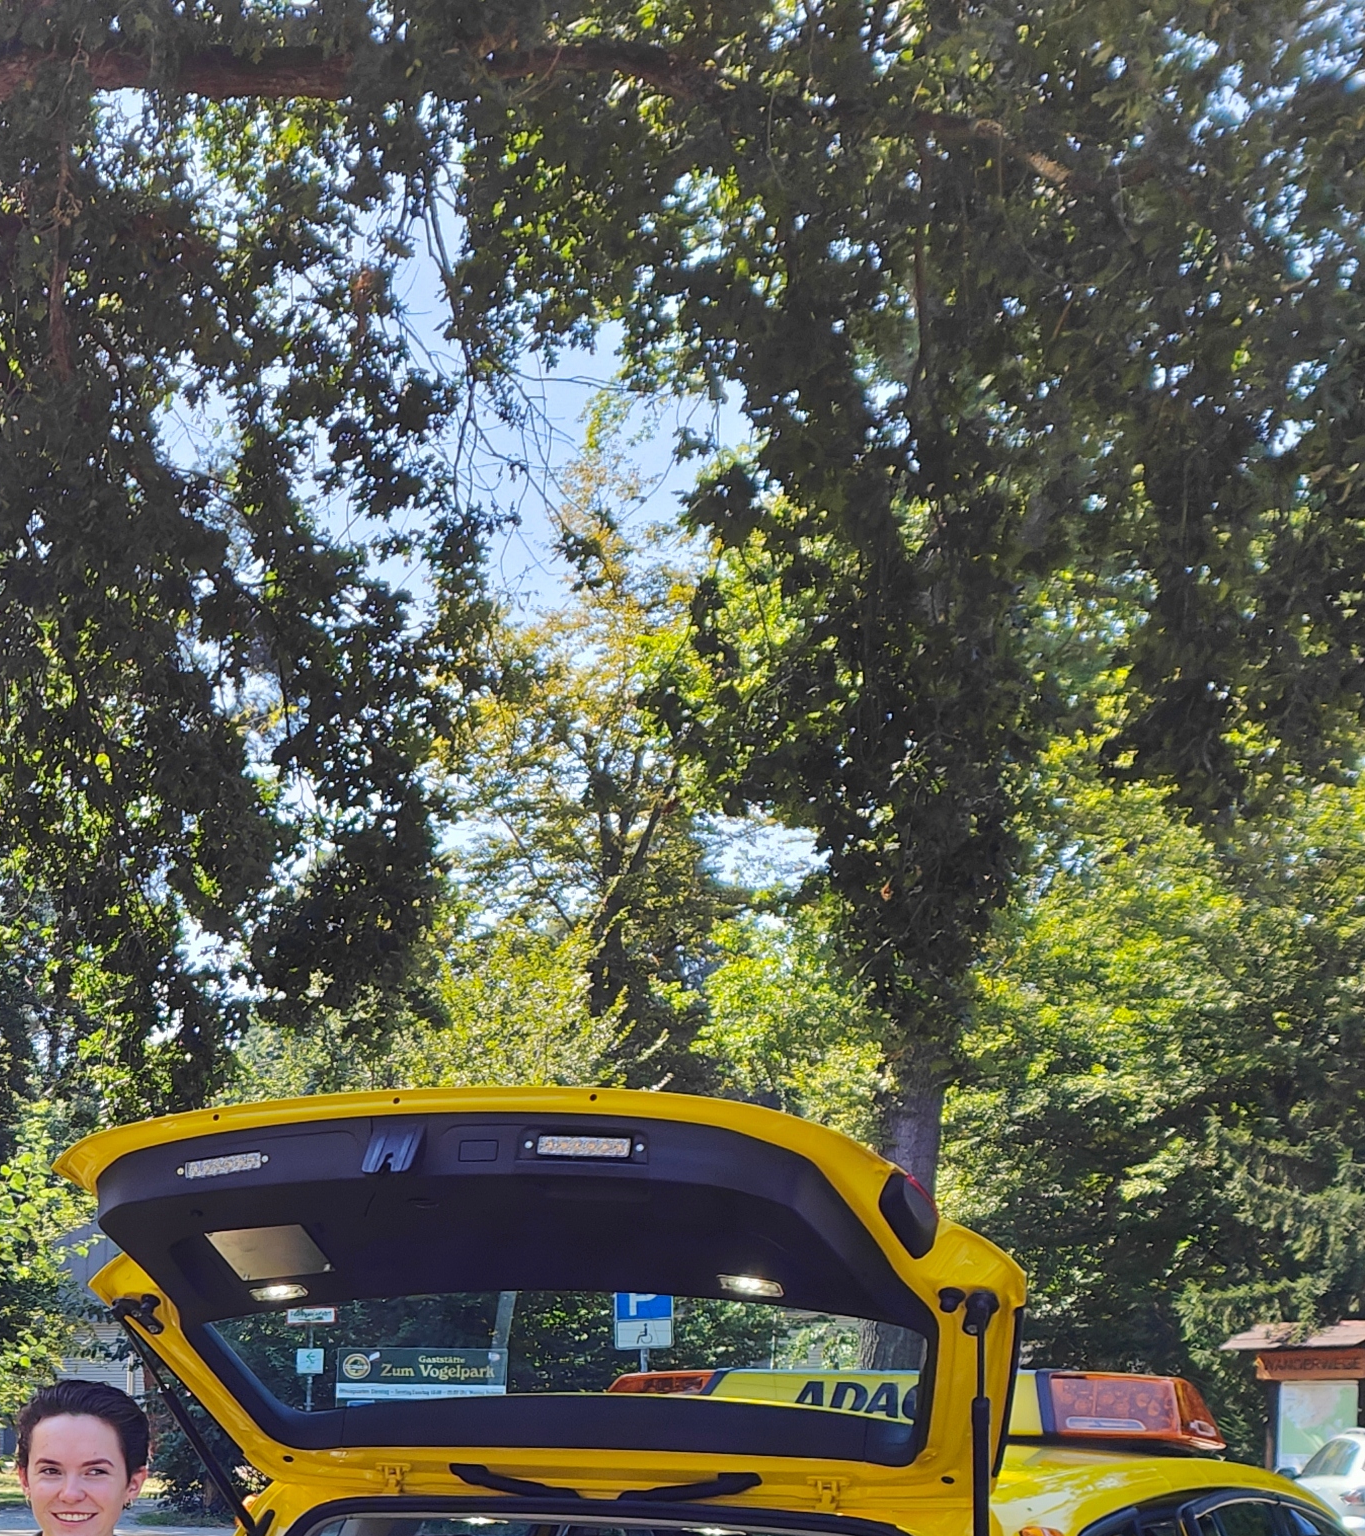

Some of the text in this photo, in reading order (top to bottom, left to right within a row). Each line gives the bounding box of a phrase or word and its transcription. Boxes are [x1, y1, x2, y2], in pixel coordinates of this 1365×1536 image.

[418, 1355, 466, 1364] Gaststätte
[380, 1363, 415, 1377] Zum
[419, 1364, 495, 1380] Vogelpark
